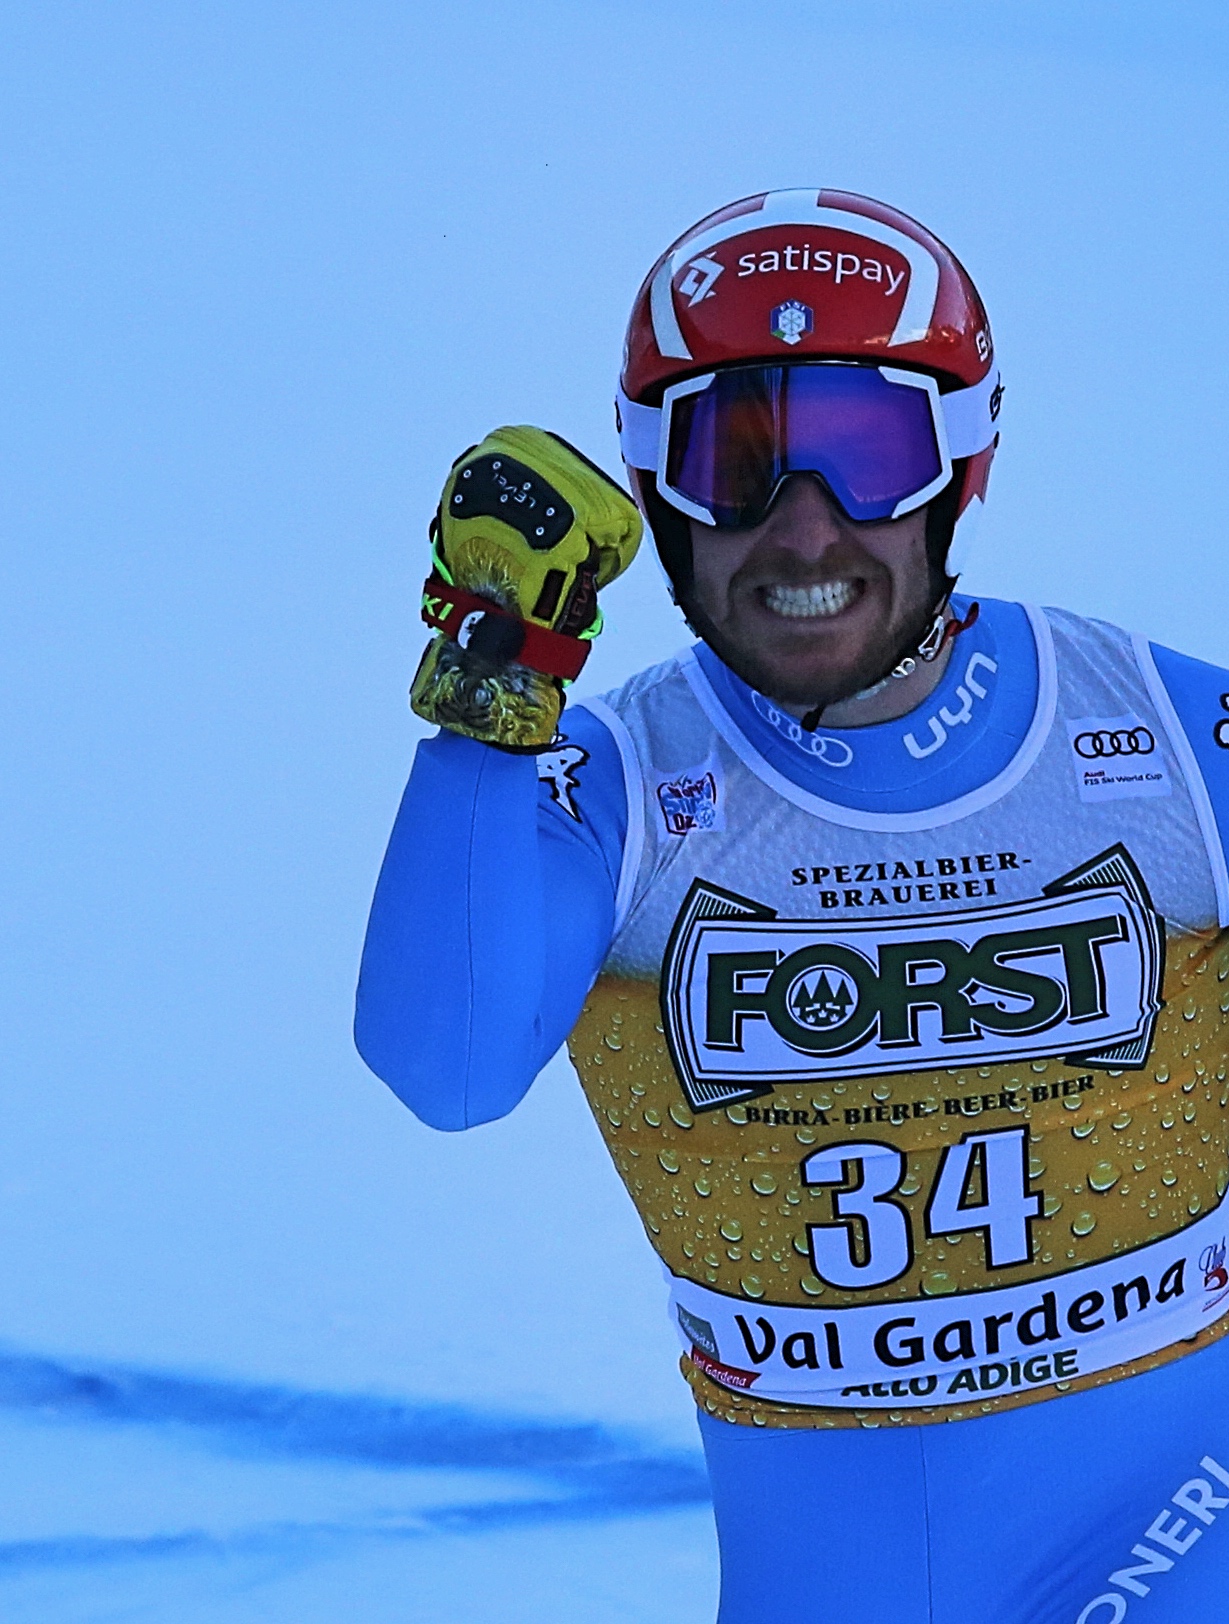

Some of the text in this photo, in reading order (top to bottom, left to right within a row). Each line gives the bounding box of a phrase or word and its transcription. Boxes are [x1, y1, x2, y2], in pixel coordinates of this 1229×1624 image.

[737, 244, 905, 296] satispay
[1084, 770, 1105, 778] Audi
[1084, 778, 1100, 786] FIS
[1116, 774, 1144, 783] World
[1145, 773, 1163, 781] Cup
[791, 852, 1032, 886] SPEZIALBIER-
[819, 878, 998, 909] BRAUEREI
[703, 912, 1128, 1059] FORST
[801, 1123, 1045, 1293] 34
[734, 1314, 844, 1371] Val
[873, 1257, 1187, 1367] Gardena
[705, 1364, 747, 1387] Gardena
